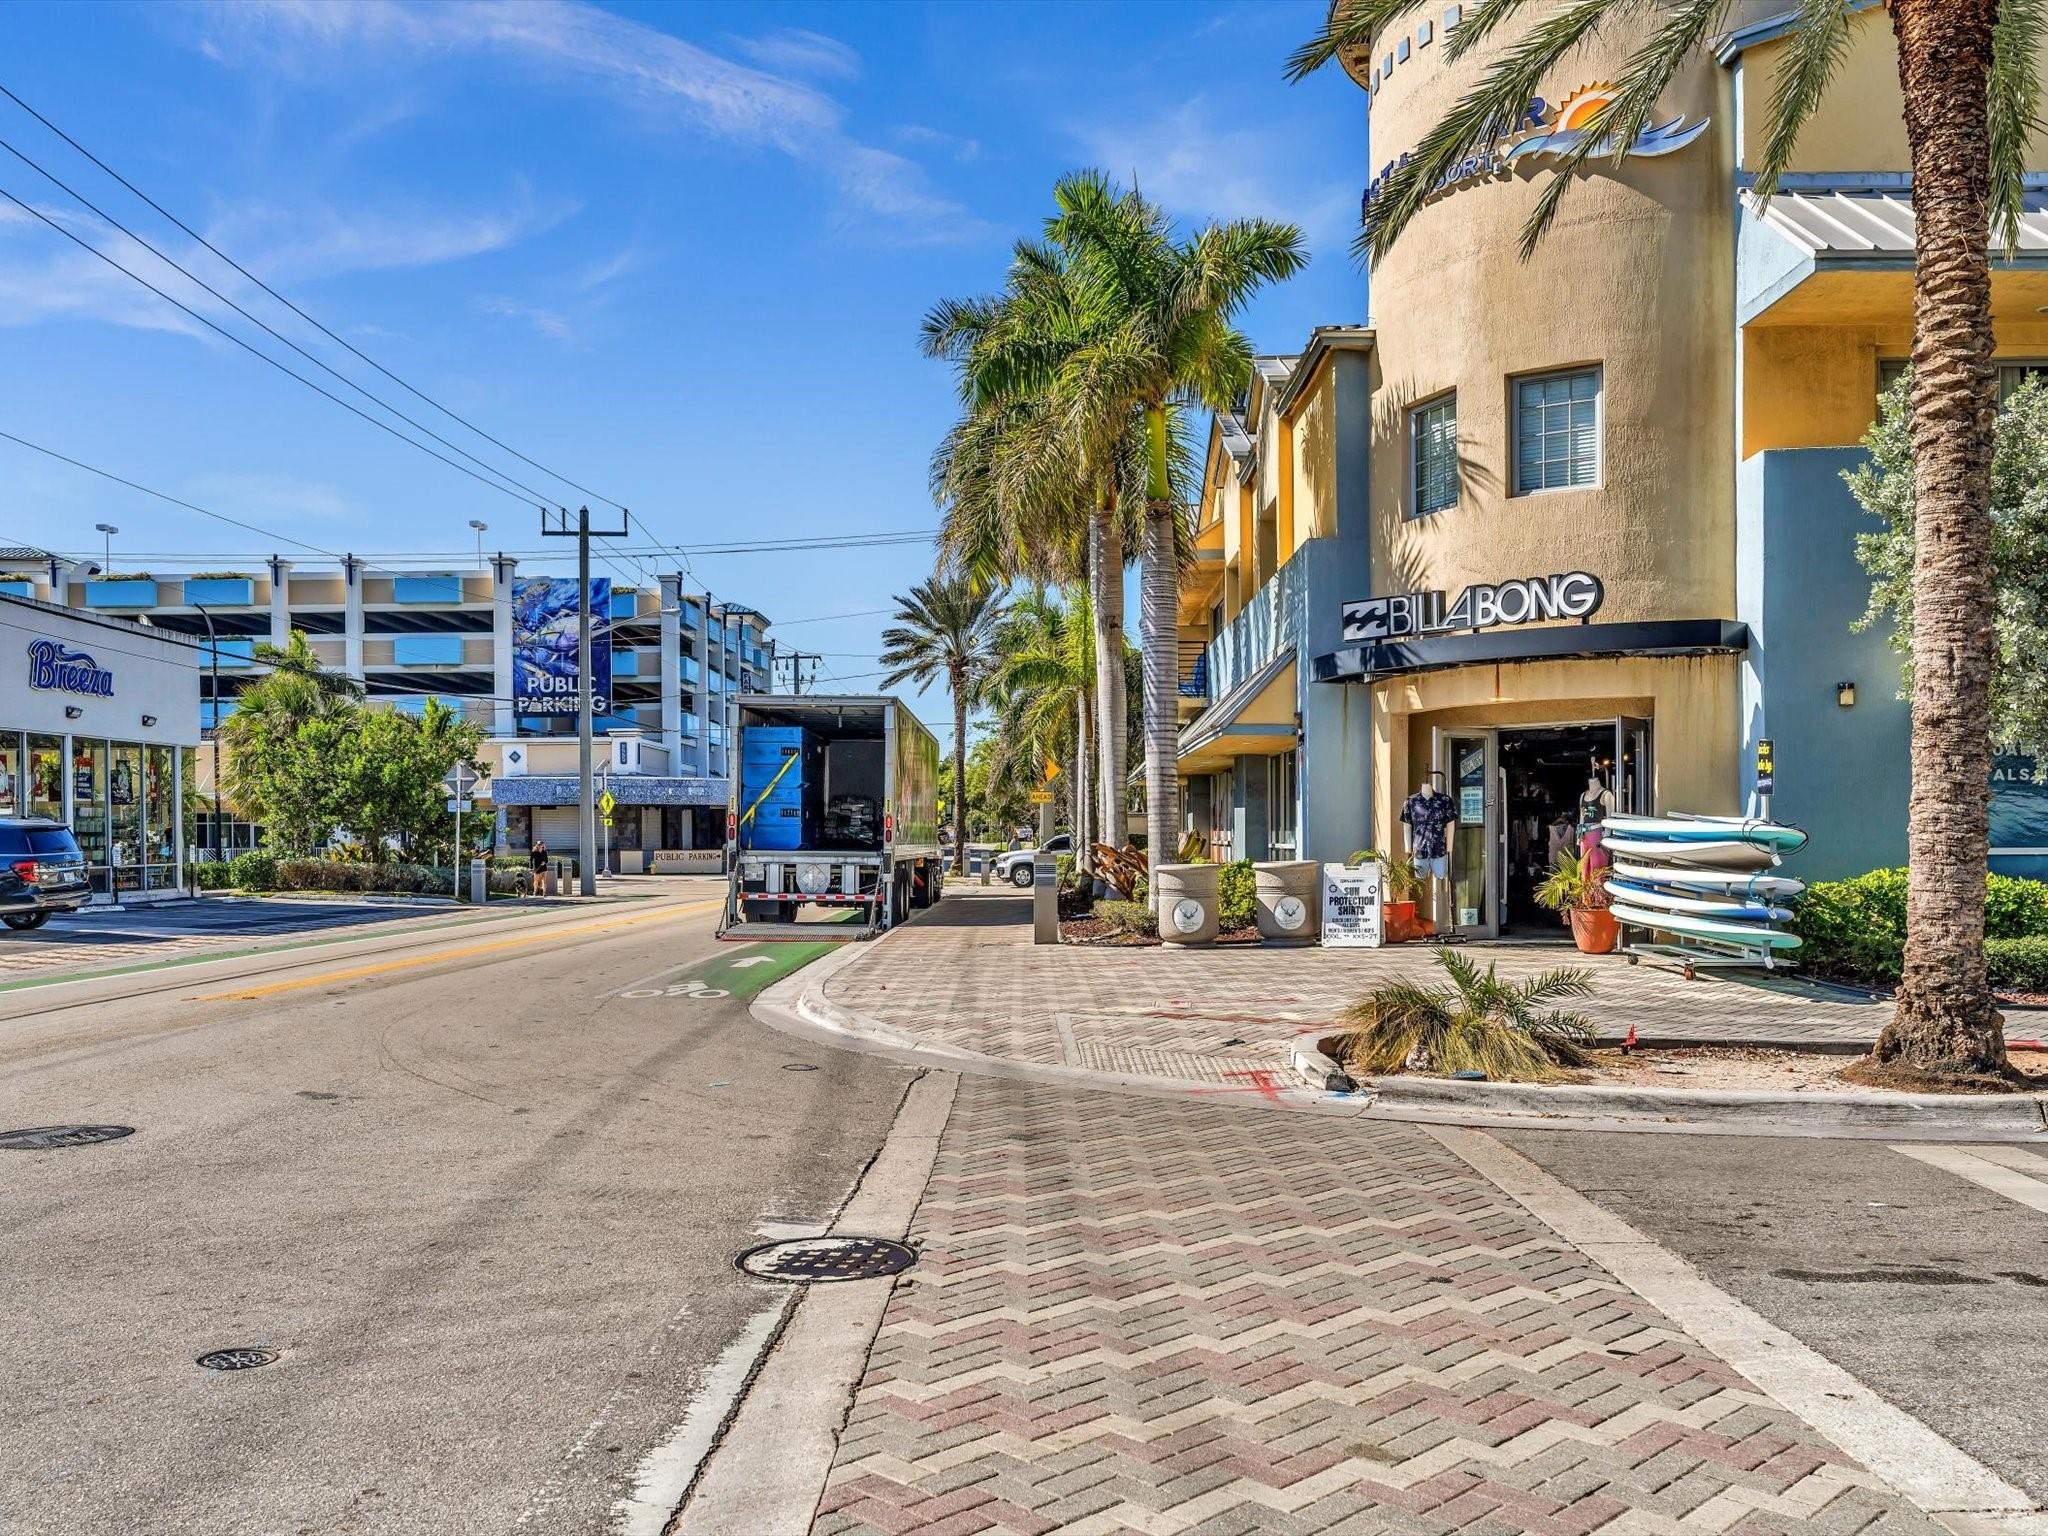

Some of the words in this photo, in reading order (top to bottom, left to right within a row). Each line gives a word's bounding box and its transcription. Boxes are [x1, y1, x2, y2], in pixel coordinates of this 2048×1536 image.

[1389, 571, 1603, 636] BILLABONG
[28, 640, 115, 697] Breeza
[656, 852, 685, 861] PUBLIC
[688, 852, 717, 860] PARKING
[1343, 886, 1360, 896] SUN
[1329, 896, 1375, 906] PROTECTION
[1337, 906, 1365, 916] SHIRTS
